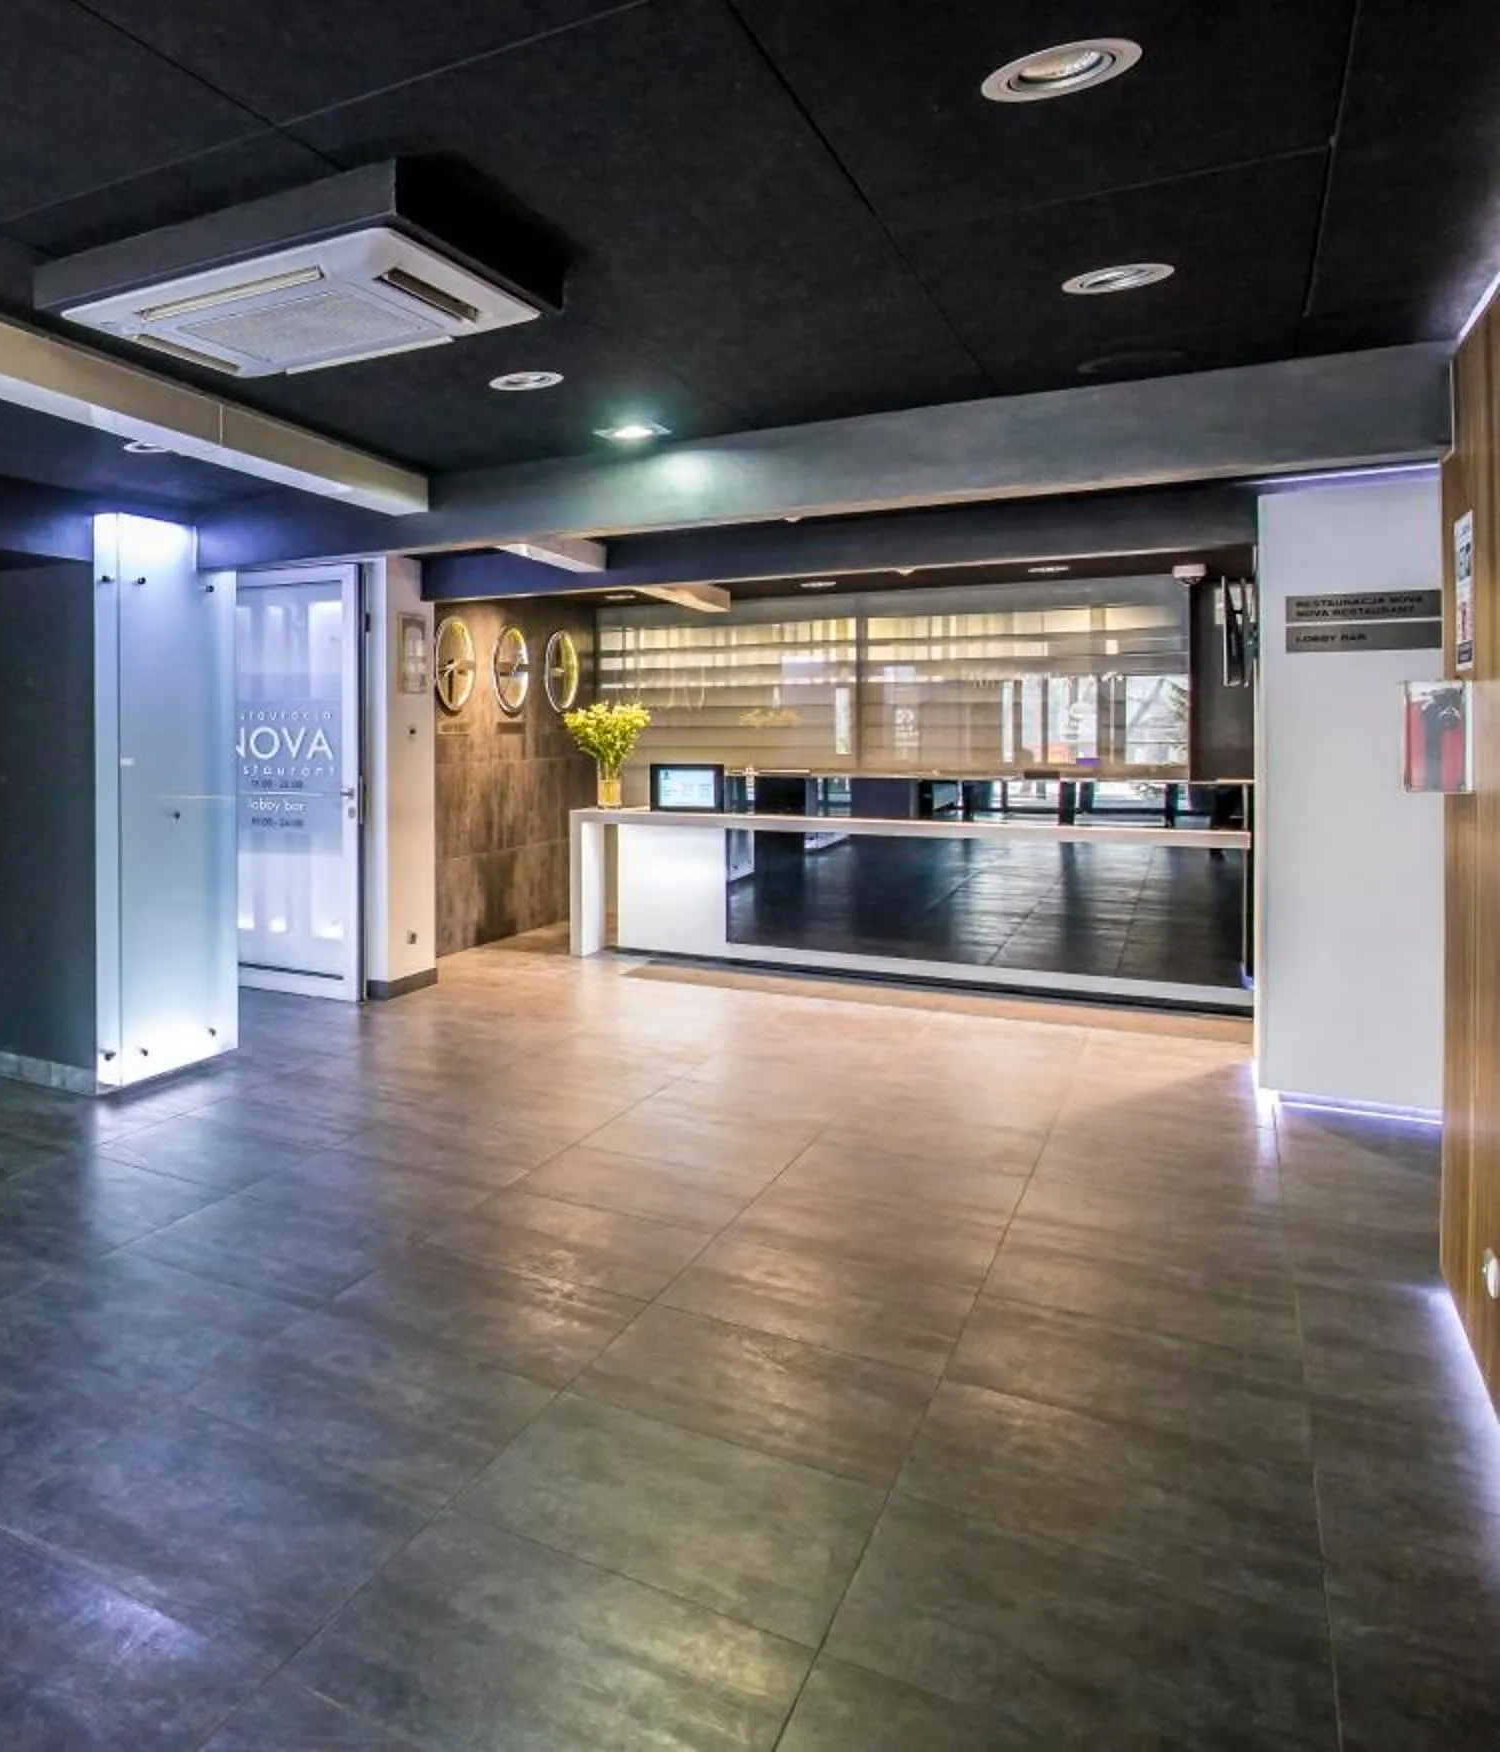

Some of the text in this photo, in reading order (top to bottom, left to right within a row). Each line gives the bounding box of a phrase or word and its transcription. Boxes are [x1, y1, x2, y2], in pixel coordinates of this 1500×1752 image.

[1295, 609, 1330, 617] NOVA
[1339, 632, 1367, 641] BAR
[239, 710, 334, 721] stauracja
[243, 764, 335, 777] staurant
